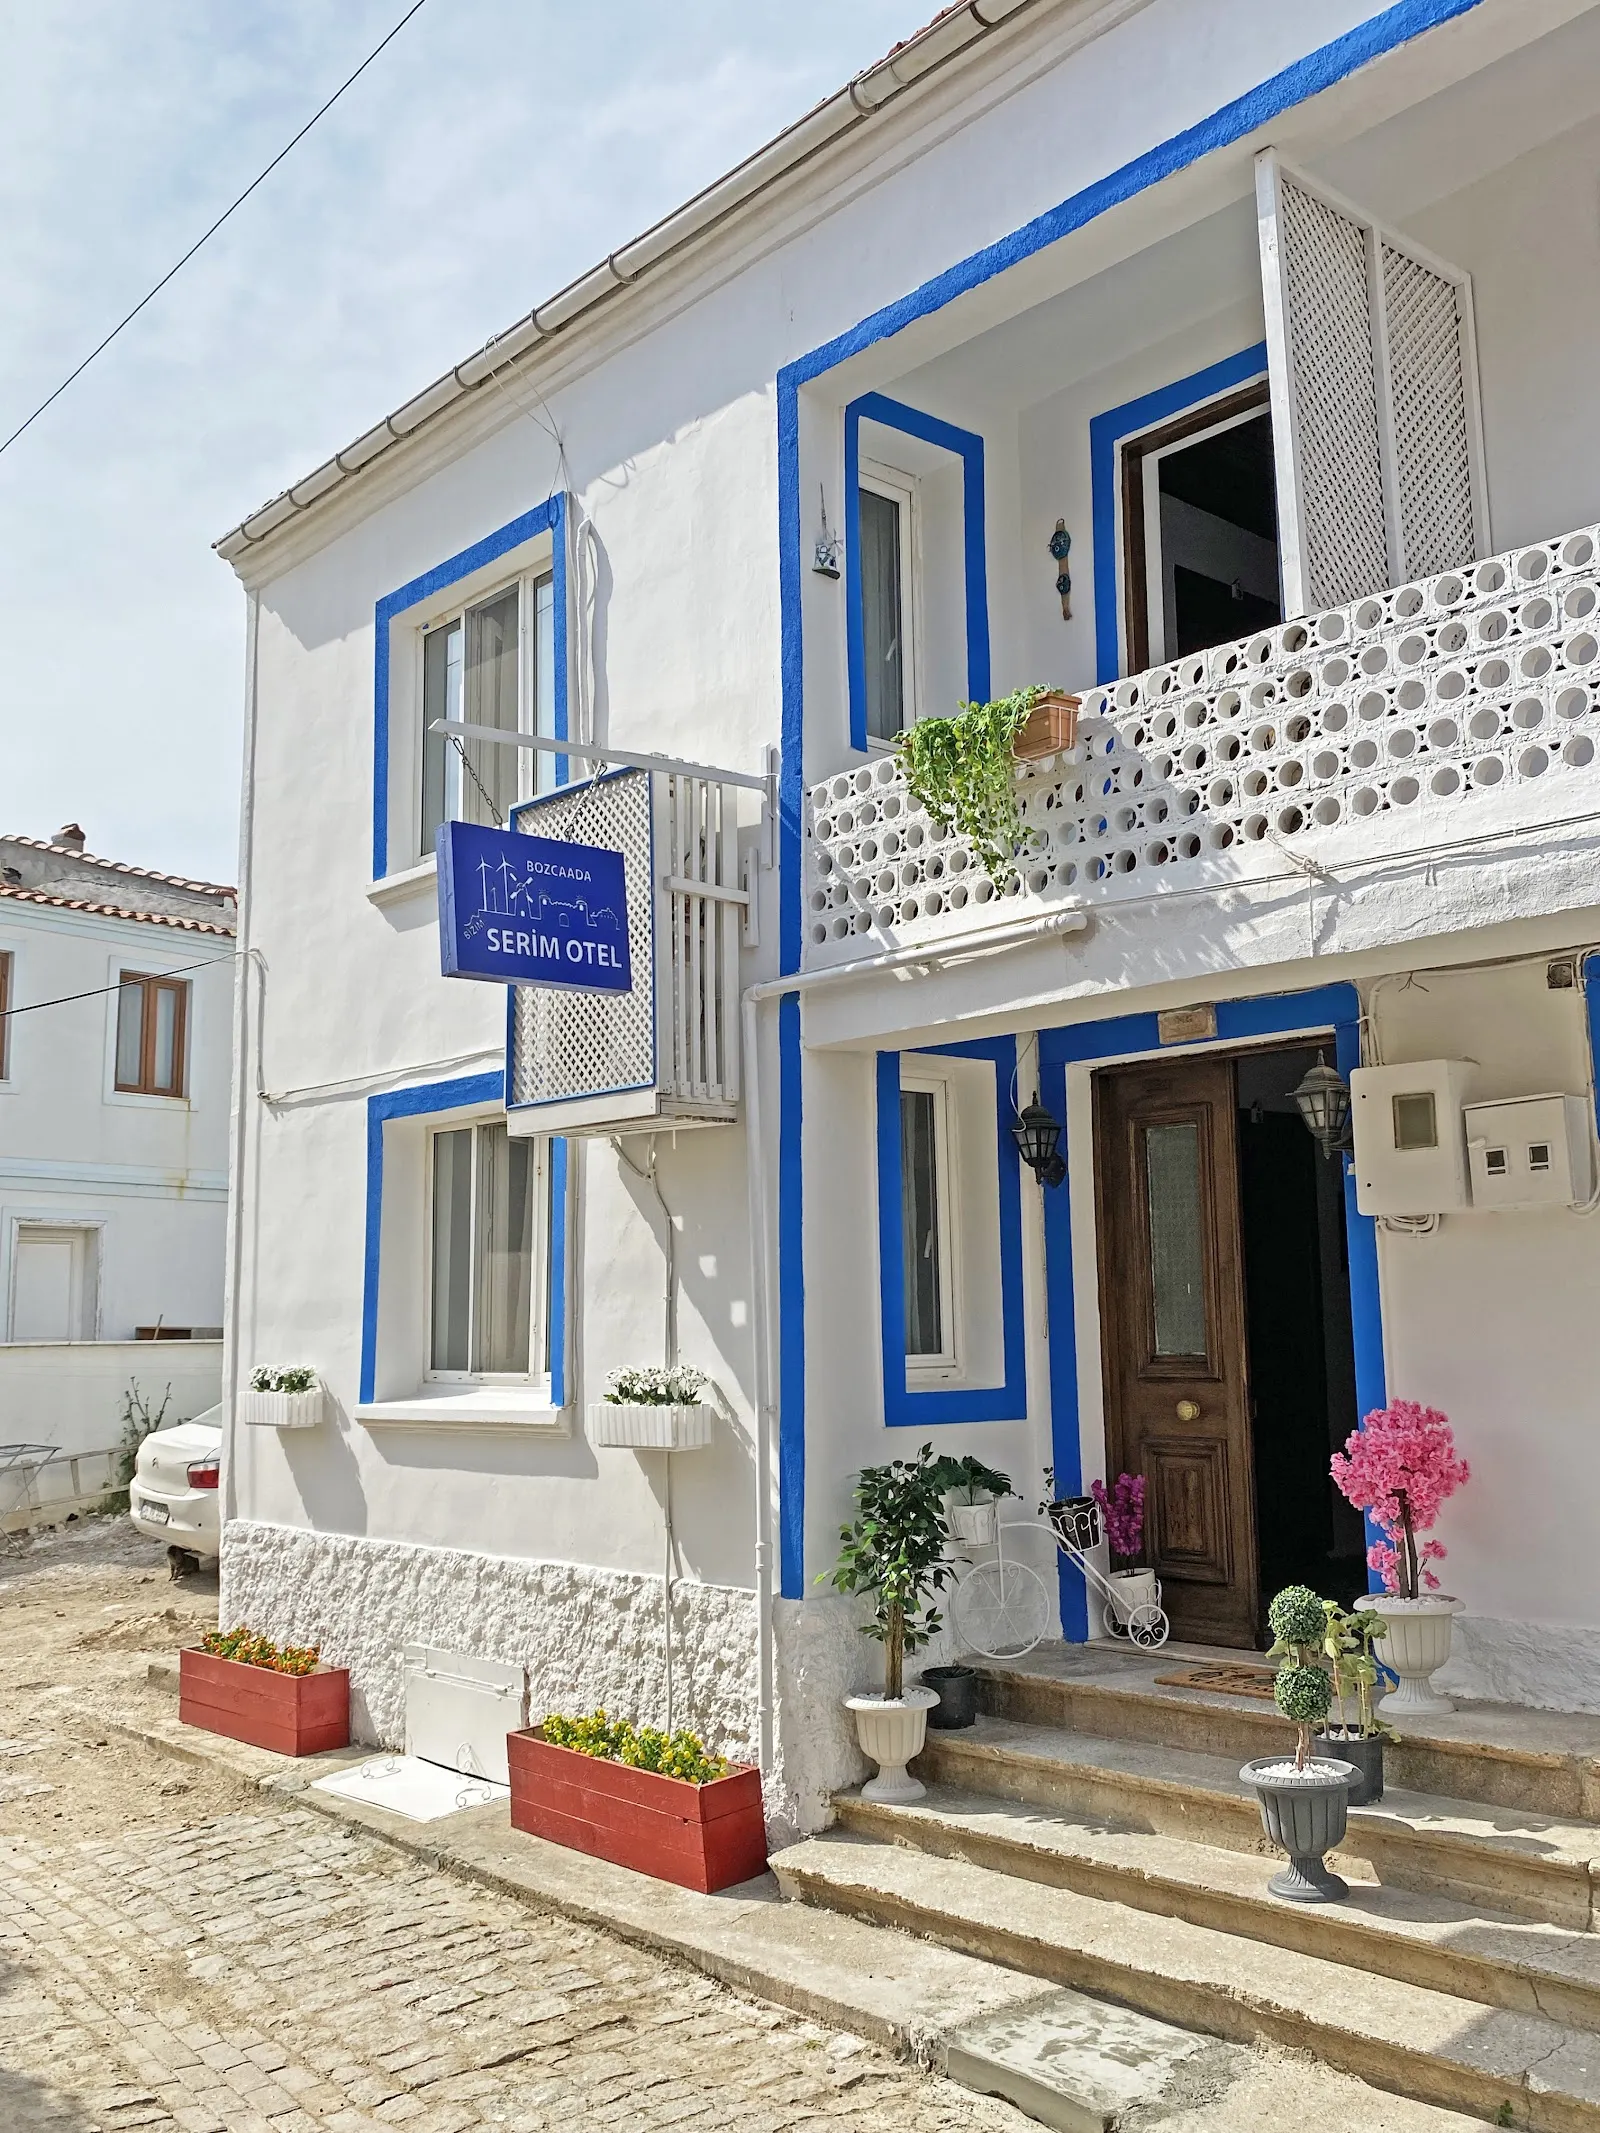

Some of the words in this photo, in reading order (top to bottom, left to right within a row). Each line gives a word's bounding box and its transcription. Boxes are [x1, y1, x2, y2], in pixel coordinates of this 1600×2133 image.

[526, 860, 592, 882] BOZCAADA
[486, 928, 560, 960] SERİM
[566, 940, 623, 969] OTEL
